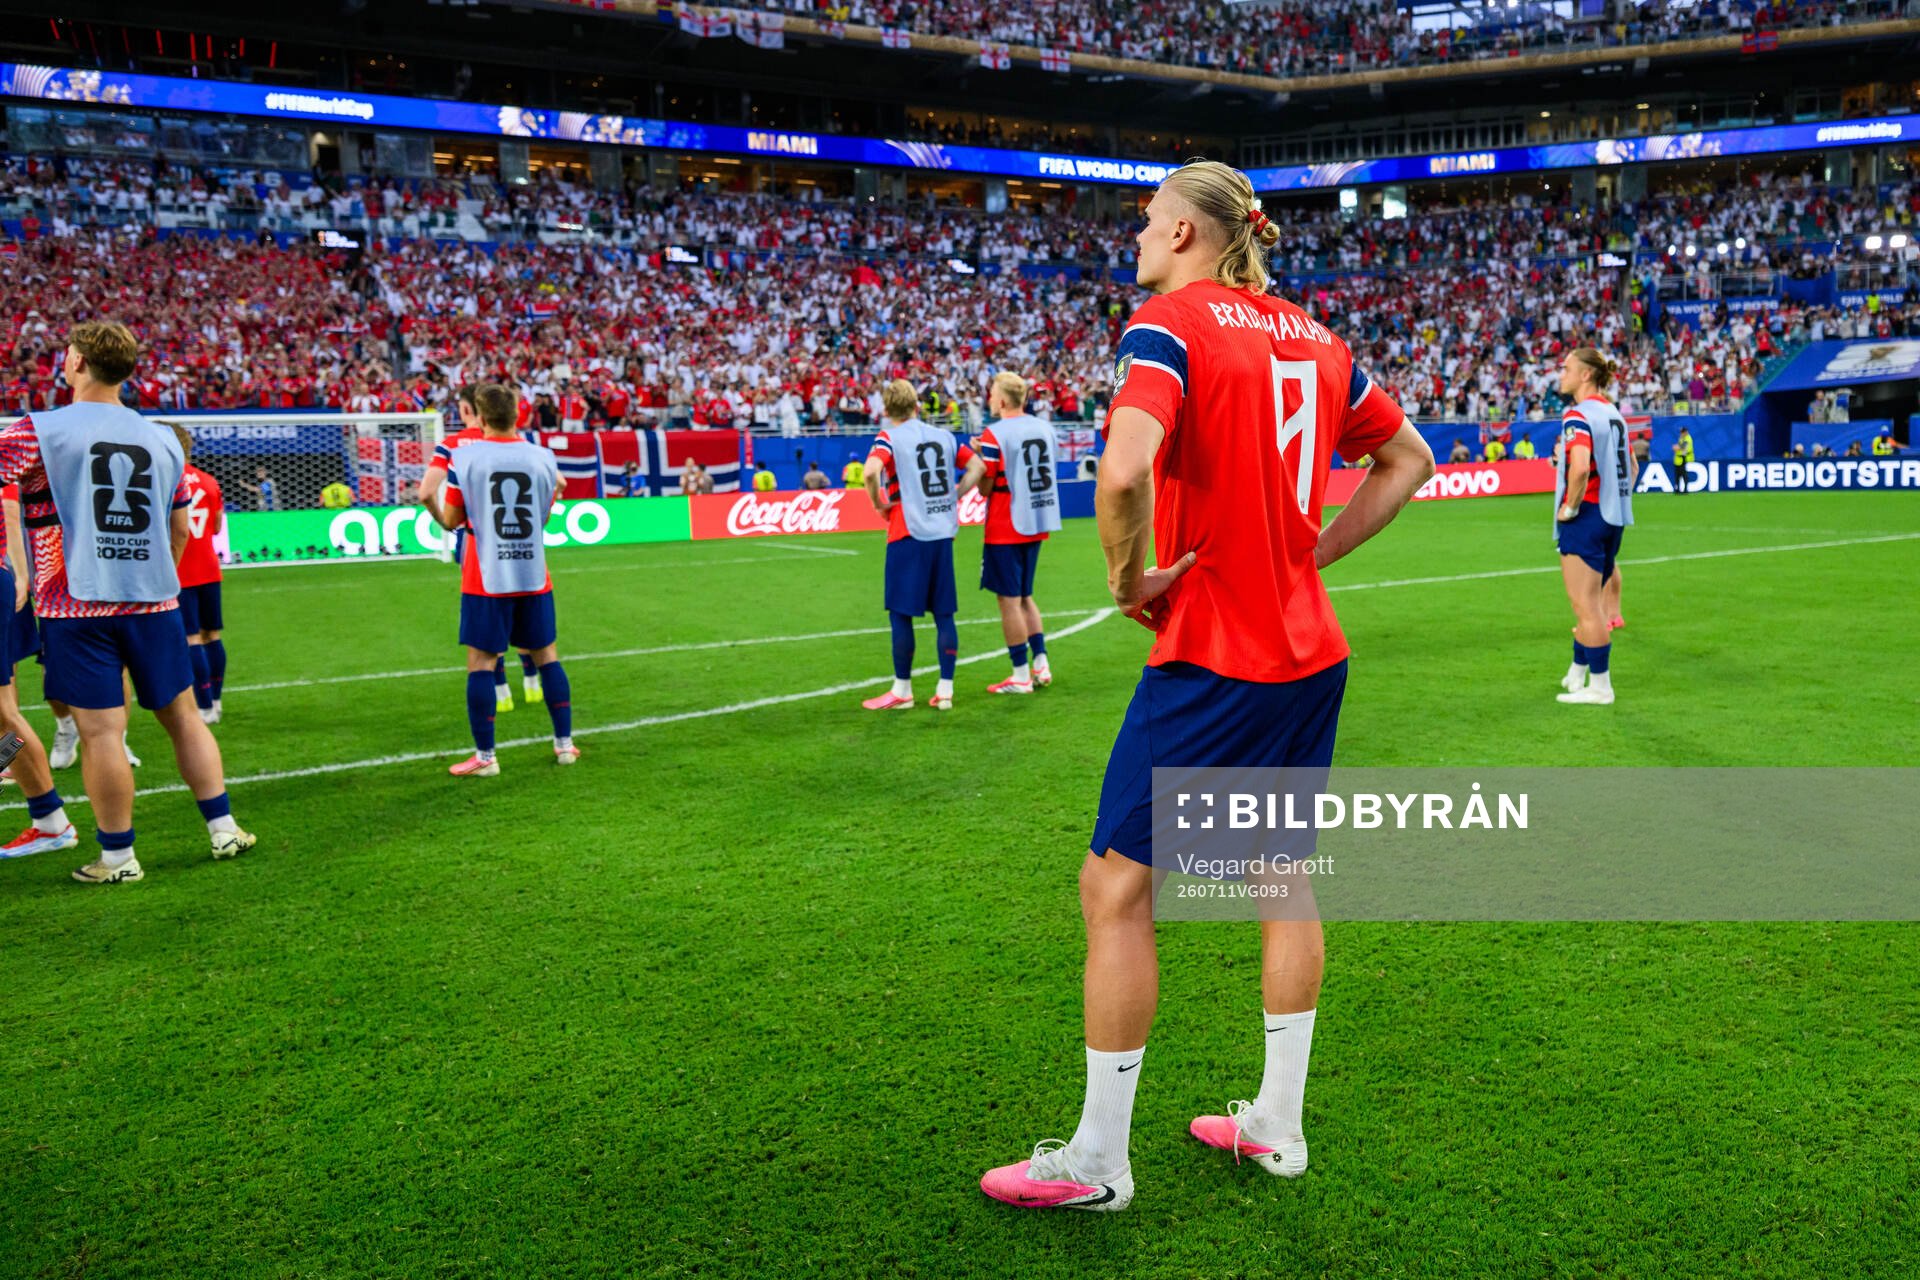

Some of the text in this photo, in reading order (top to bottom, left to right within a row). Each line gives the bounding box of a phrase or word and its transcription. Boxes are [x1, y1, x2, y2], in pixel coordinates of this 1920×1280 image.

[748, 132, 818, 155] MIAMI
[1039, 157, 1076, 176] FIFA
[1076, 160, 1134, 180] WORLD
[1135, 165, 1167, 182] CUP
[1430, 153, 1496, 174] MIAMI
[104, 514, 134, 526] FIFA
[726, 491, 846, 536] Coca-Cola
[127, 538, 150, 547] CUP
[497, 551, 534, 561] 2026
